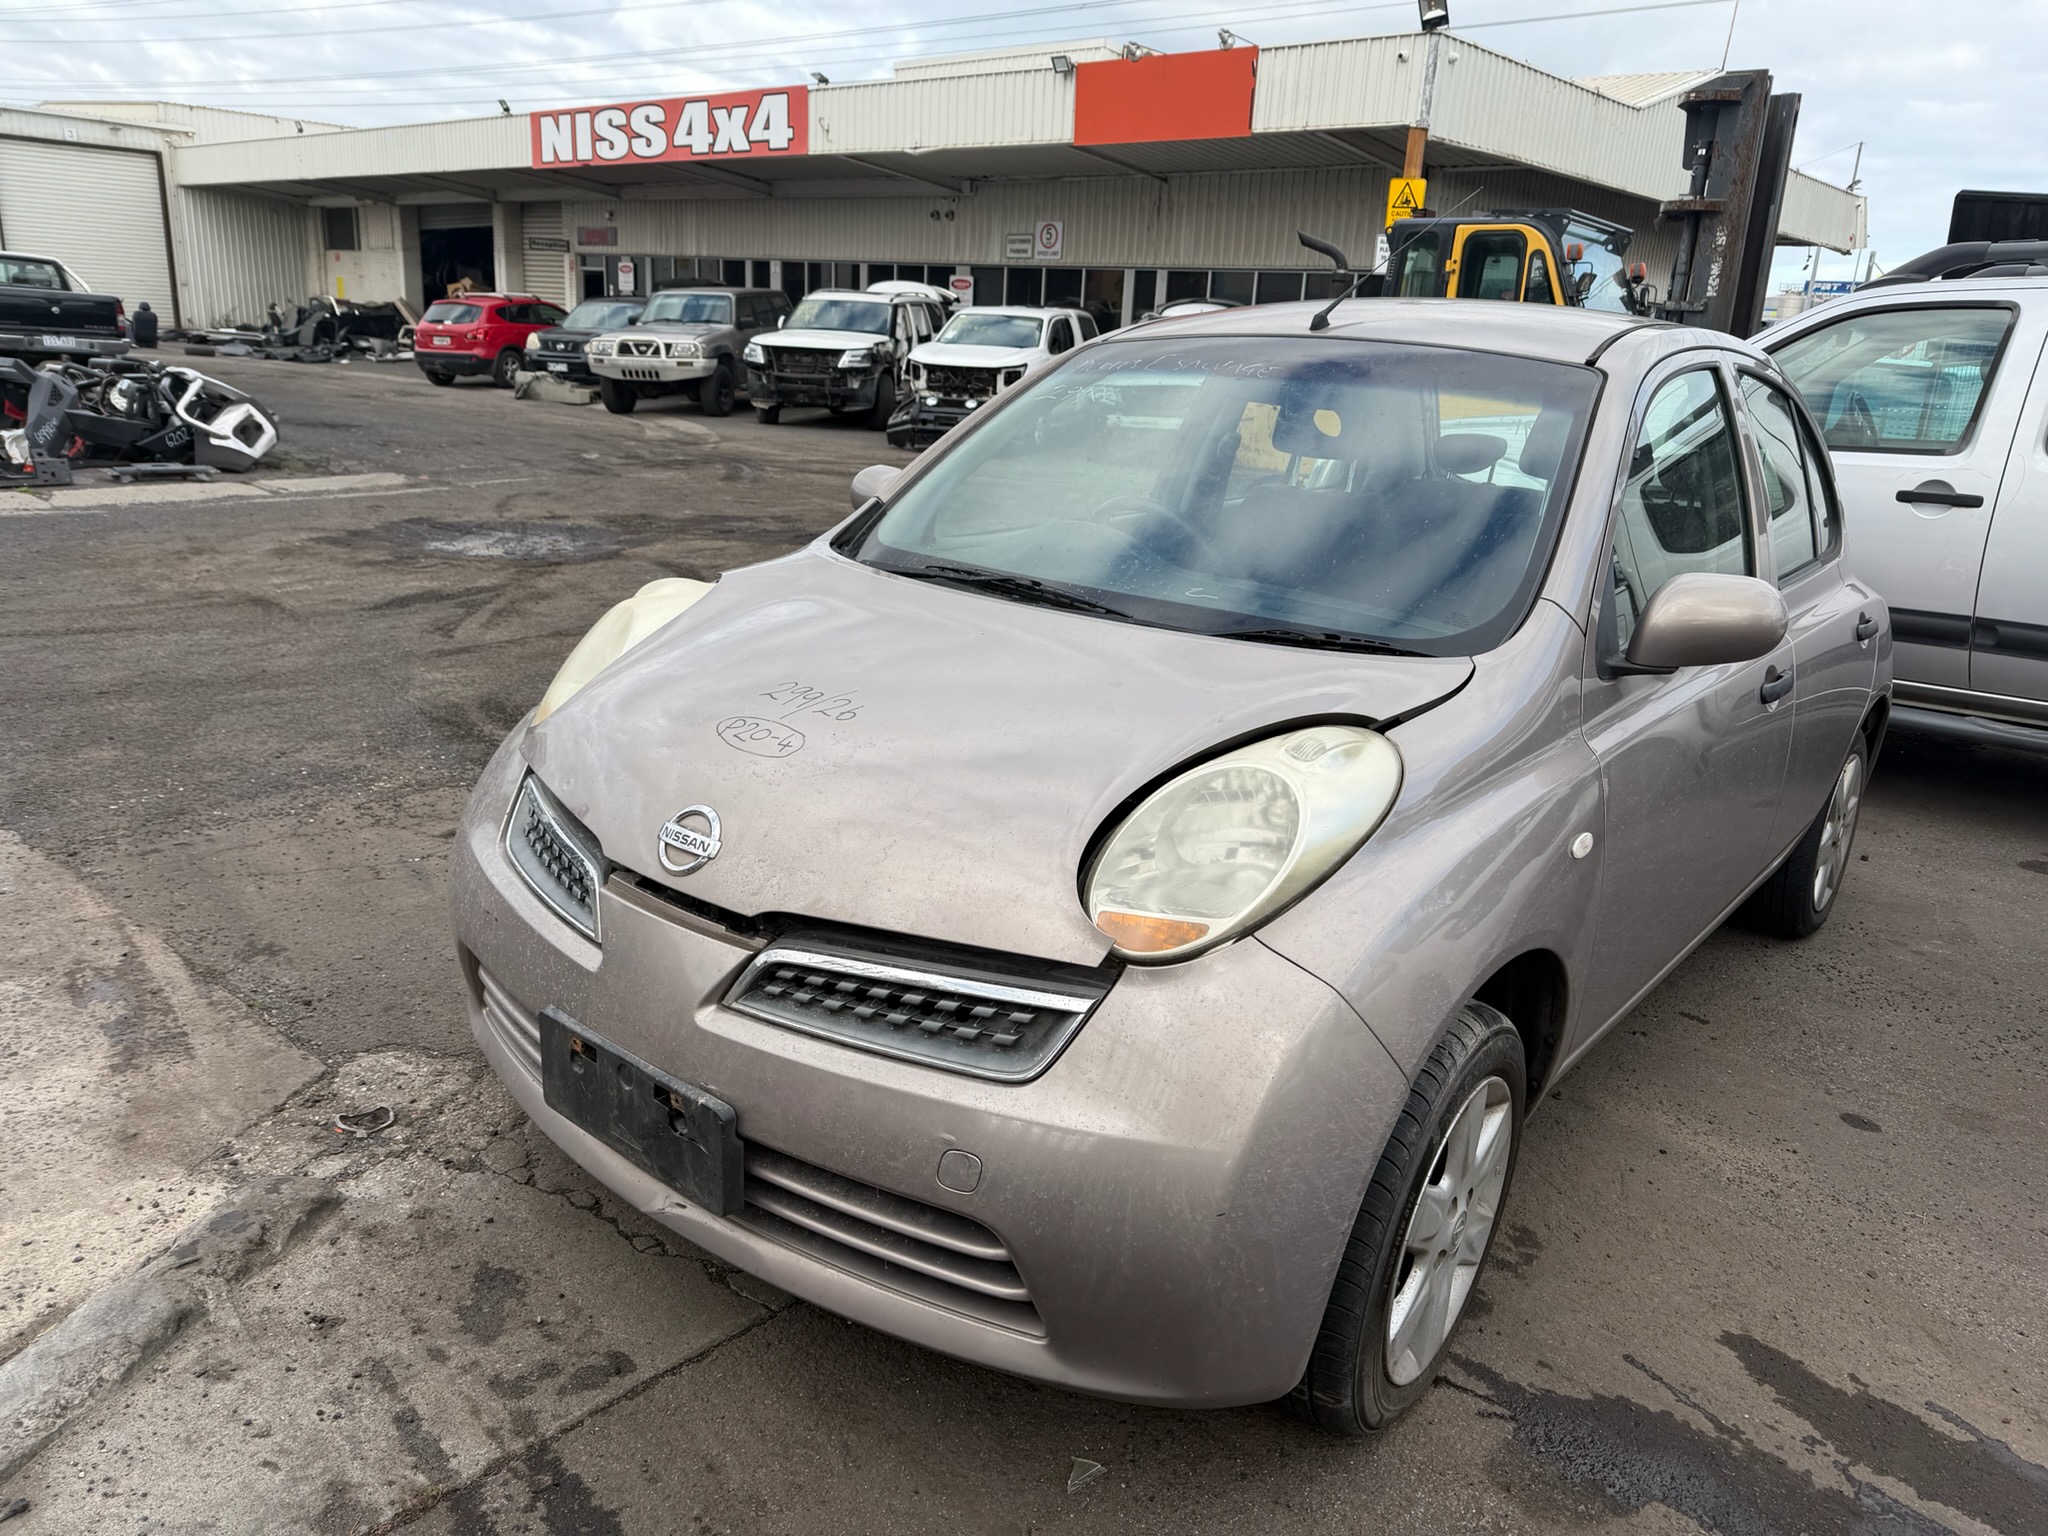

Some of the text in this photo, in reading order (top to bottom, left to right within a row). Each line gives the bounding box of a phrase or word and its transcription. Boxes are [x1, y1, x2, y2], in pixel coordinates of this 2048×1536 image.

[1045, 227, 1053, 241] 5
[759, 681, 864, 721] 299/26
[661, 825, 711, 853] NISSAN
